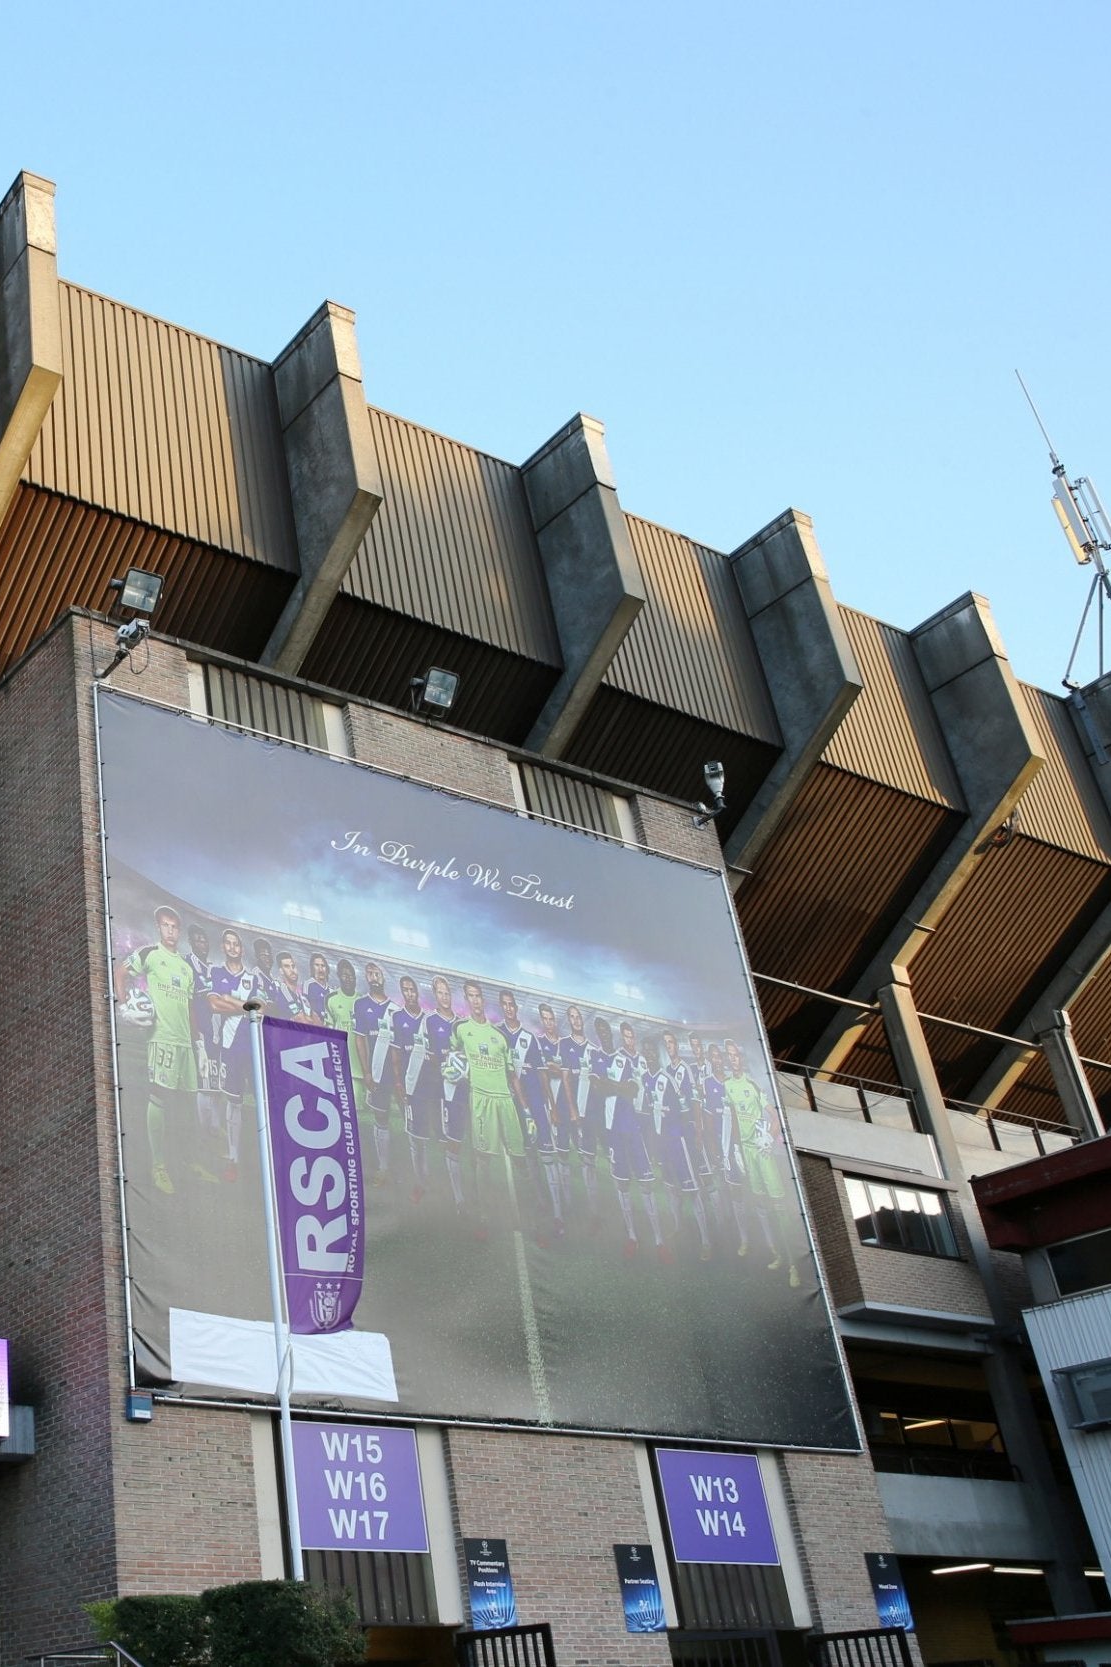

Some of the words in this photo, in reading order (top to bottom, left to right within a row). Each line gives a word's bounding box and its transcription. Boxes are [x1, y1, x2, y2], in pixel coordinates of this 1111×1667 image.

[330, 831, 371, 857] In
[376, 840, 461, 891] Purple
[466, 863, 502, 892] We
[506, 873, 575, 911] Trust
[330, 1042, 352, 1118] ANDERLECHT
[343, 1121, 355, 1155] CLUB
[280, 1041, 349, 1273] RSCA
[347, 1159, 360, 1226] SPORTING
[346, 1229, 358, 1273] ROYAL
[320, 1431, 383, 1464] W15
[324, 1469, 387, 1502] W16
[689, 1474, 739, 1504] W13
[327, 1508, 389, 1540] W17
[695, 1509, 747, 1537] W14
